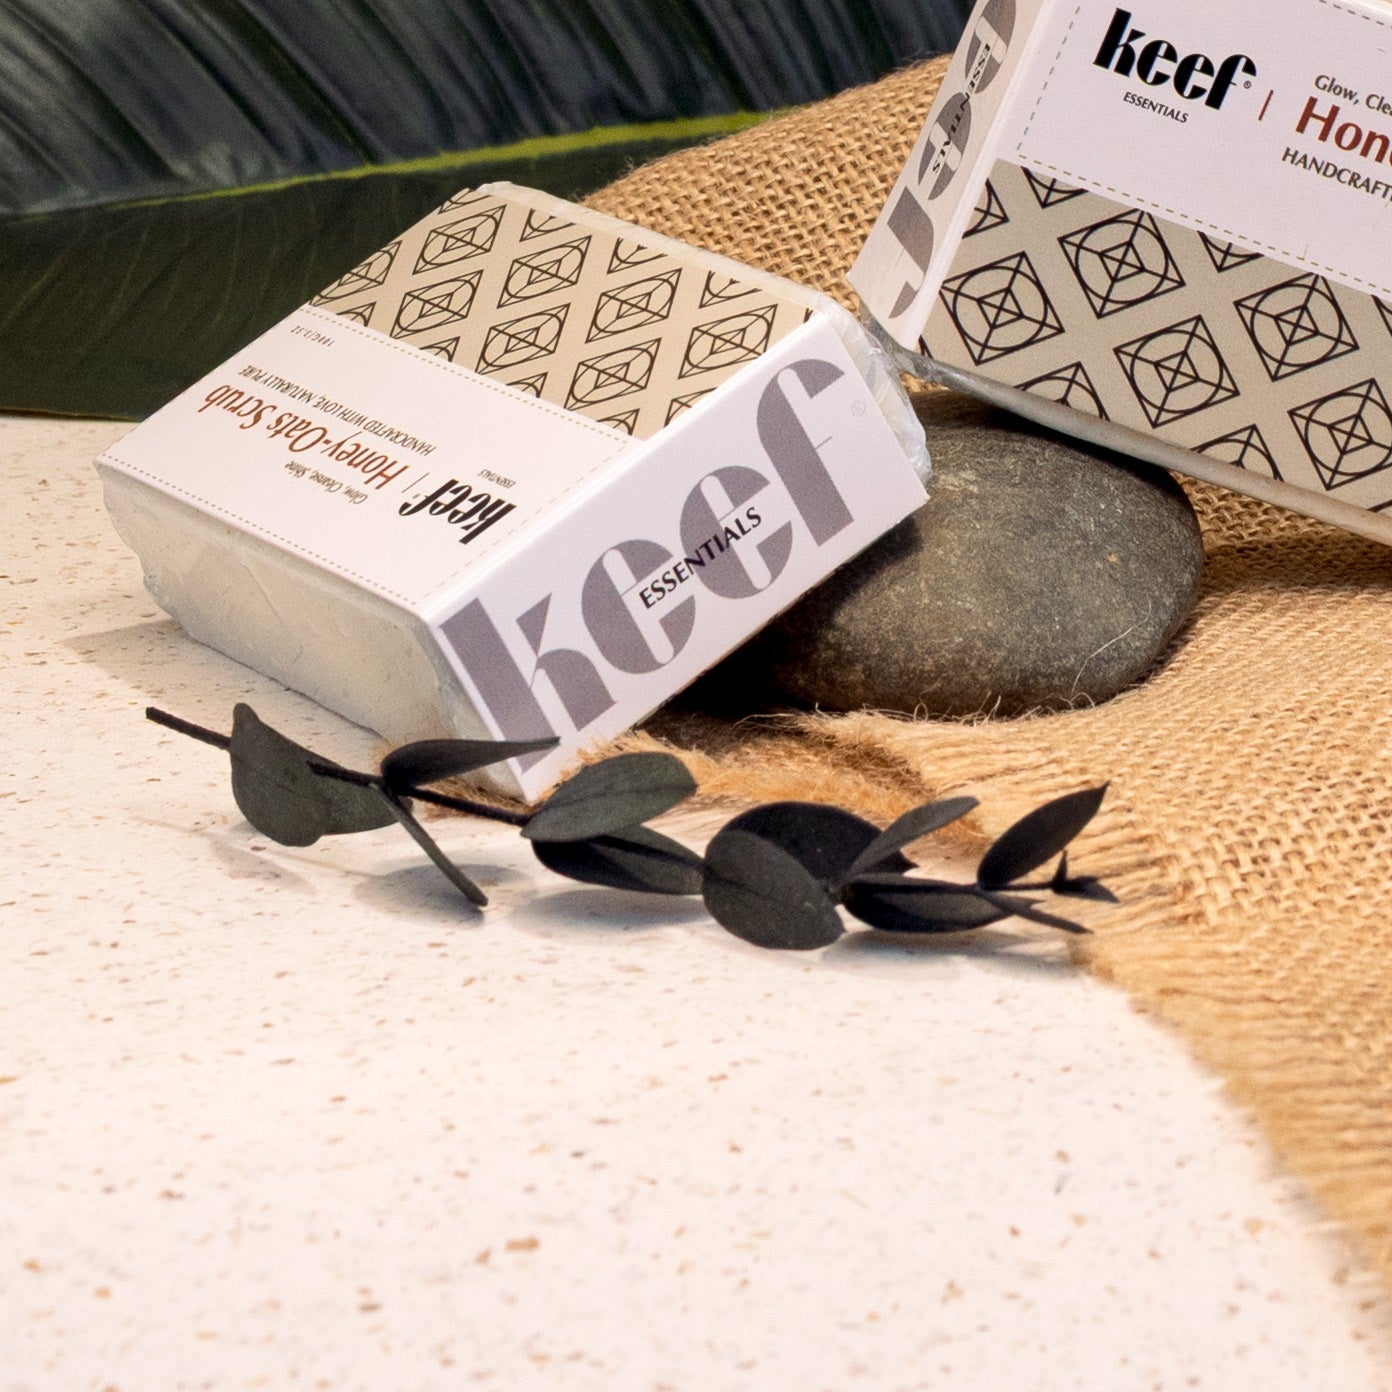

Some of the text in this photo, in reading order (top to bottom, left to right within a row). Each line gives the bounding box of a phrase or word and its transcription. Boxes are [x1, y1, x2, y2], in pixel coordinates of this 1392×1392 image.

[1093, 7, 1257, 111] keef
[1314, 74, 1359, 105] Glow,
[932, 42, 991, 175] ESSENTIALS
[1123, 91, 1189, 123] ESSENTIALS
[238, 365, 268, 382] PURE
[259, 374, 318, 404] NATURALLY
[336, 408, 368, 427] WITH
[198, 385, 410, 490] Honey-Oats Scrub
[362, 420, 437, 457] HANDCRAFTED
[284, 460, 312, 478] Shine
[477, 469, 517, 489] ESSENTIALS
[398, 478, 517, 545] keef
[439, 358, 846, 774] keef
[638, 506, 762, 610] ESSENTIALS
